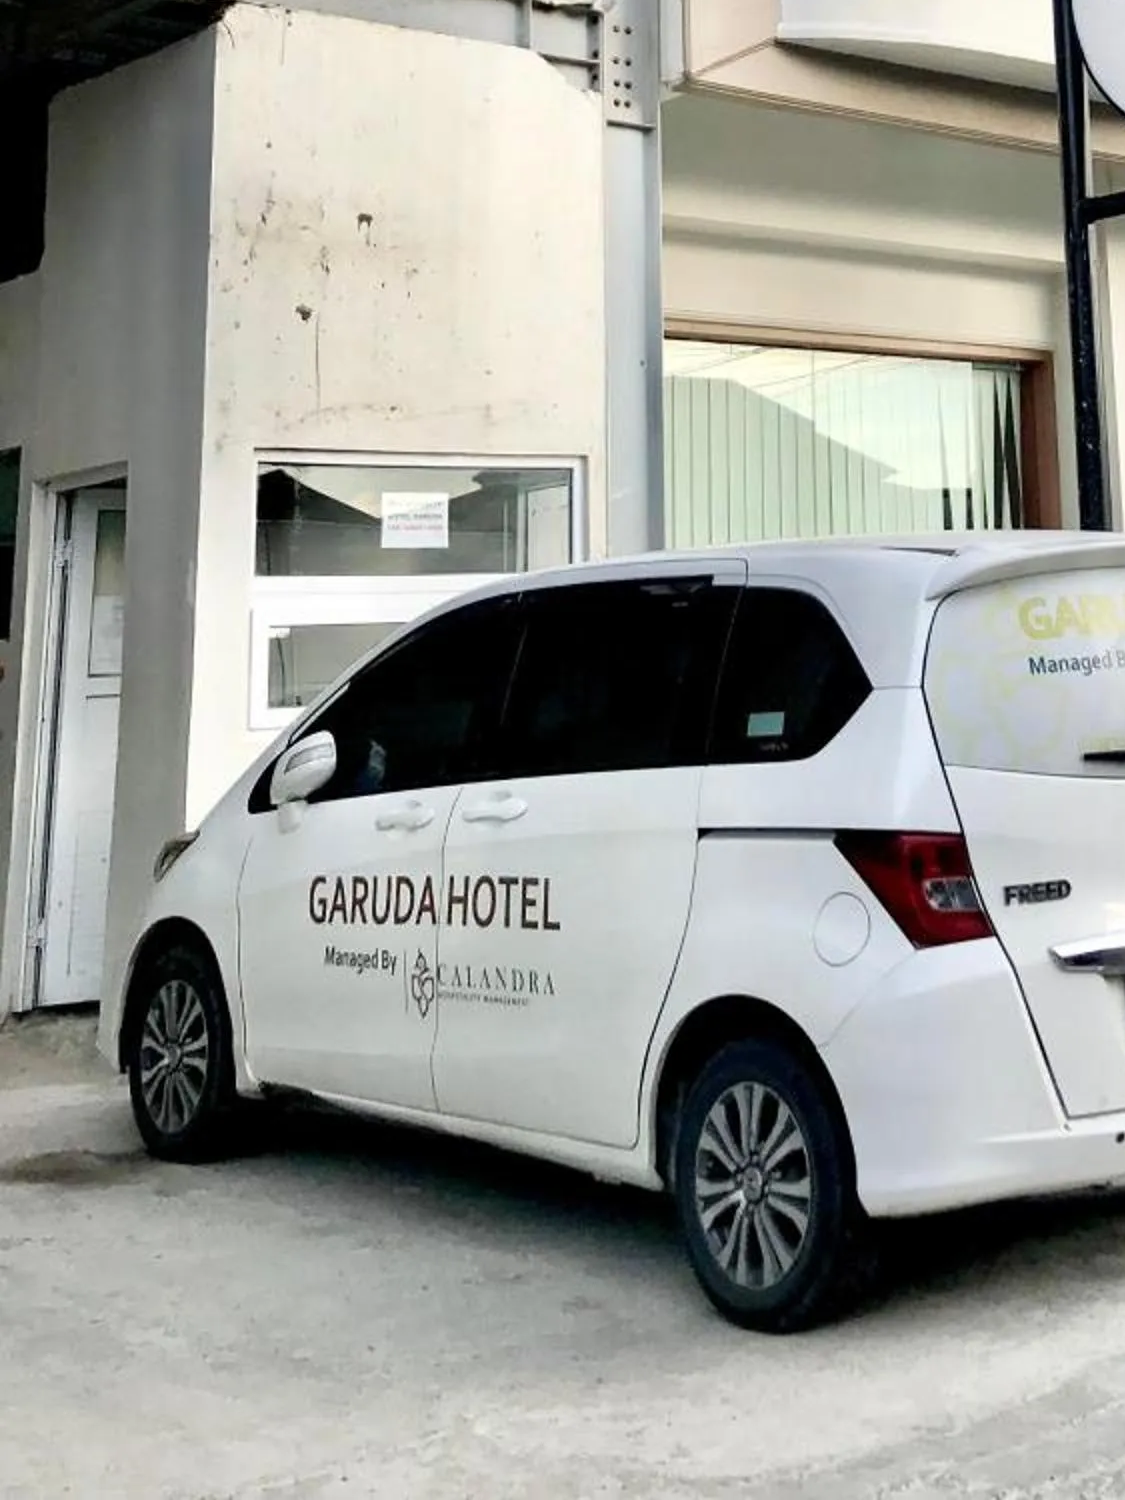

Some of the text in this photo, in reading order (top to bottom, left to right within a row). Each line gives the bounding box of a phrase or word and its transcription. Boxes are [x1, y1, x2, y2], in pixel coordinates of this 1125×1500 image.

[1028, 651, 1113, 676] Managed
[309, 875, 560, 930] GARUDA HOTEL
[1003, 879, 1072, 906] FREED
[324, 946, 397, 975] Managed By
[436, 963, 555, 995] CALANDRA
